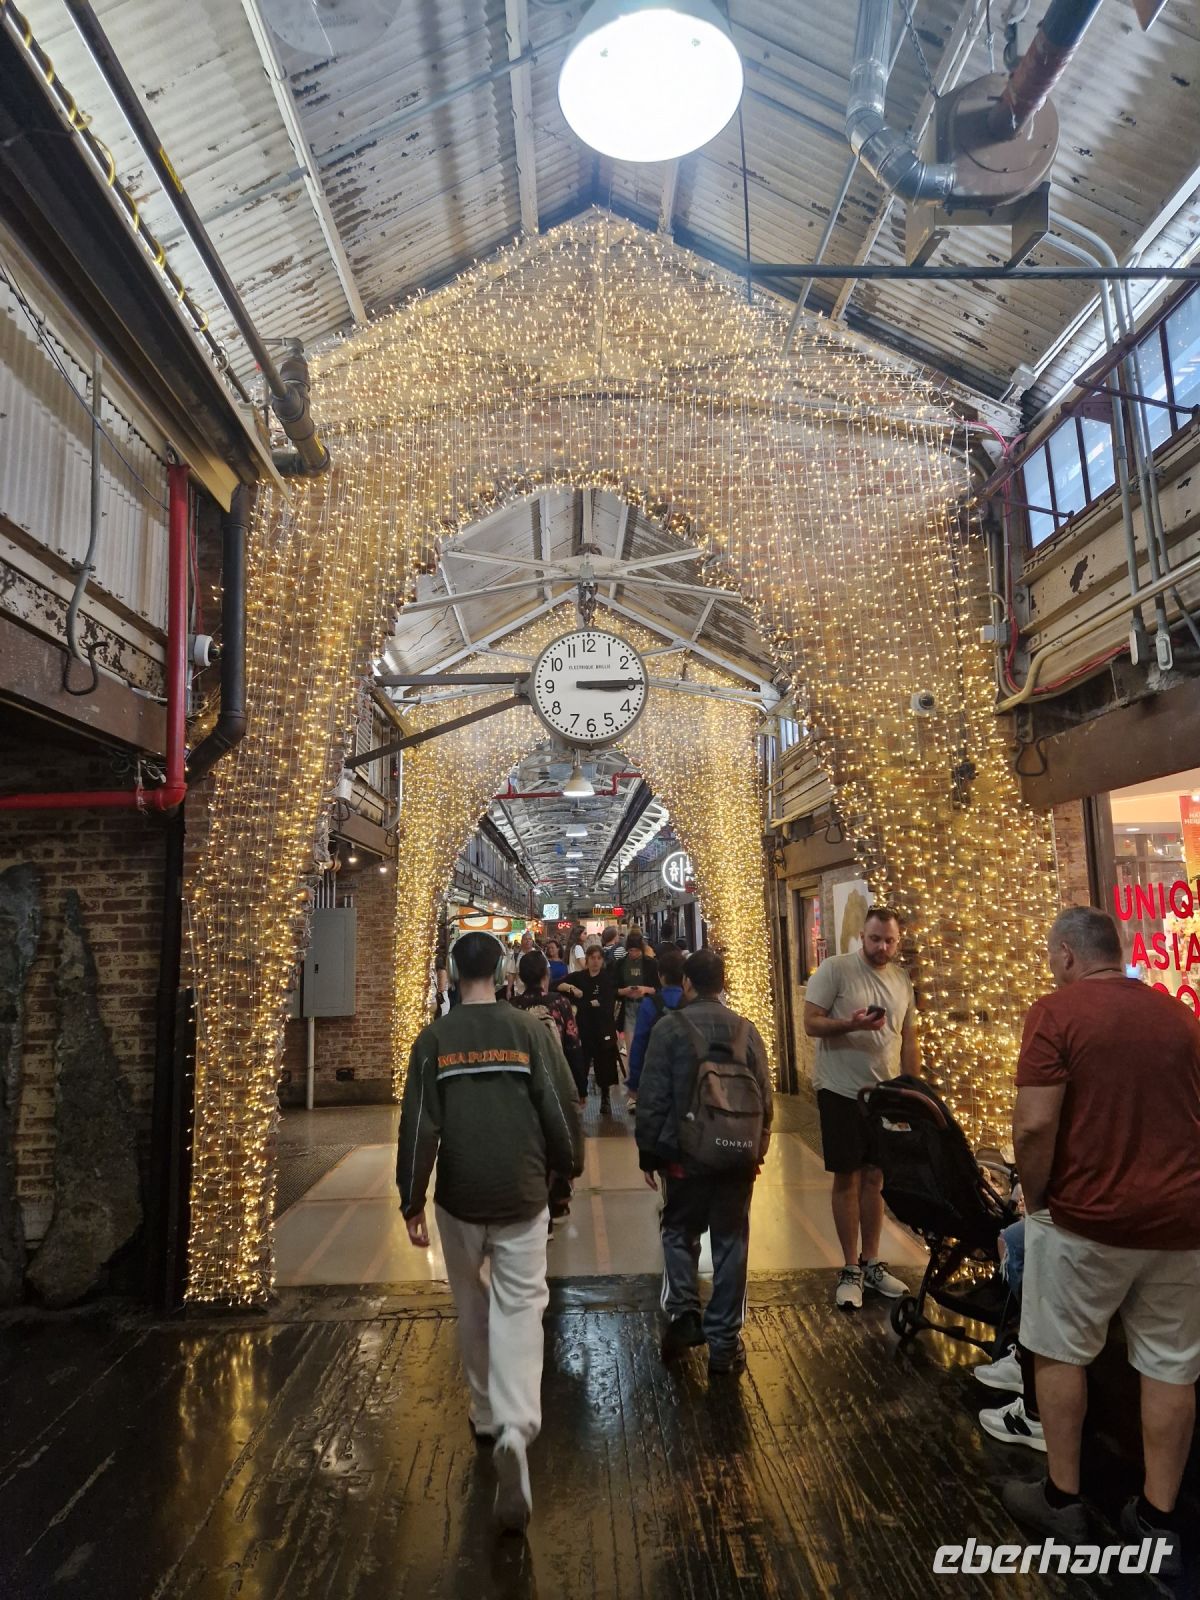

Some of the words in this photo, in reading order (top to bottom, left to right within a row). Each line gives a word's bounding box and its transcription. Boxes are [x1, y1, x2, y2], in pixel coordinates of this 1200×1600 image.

[568, 644, 576, 658] 11
[582, 639, 596, 653] 12
[607, 643, 611, 657] 1
[551, 657, 563, 672] 10
[620, 656, 629, 670] 2
[545, 679, 555, 693] 9
[551, 701, 561, 715] 8
[620, 698, 631, 713] 4
[570, 713, 580, 728] 7
[586, 718, 597, 733] 6
[603, 712, 614, 727] 5
[1113, 881, 1200, 921] UNIQ
[715, 1138, 753, 1148] CONRAD
